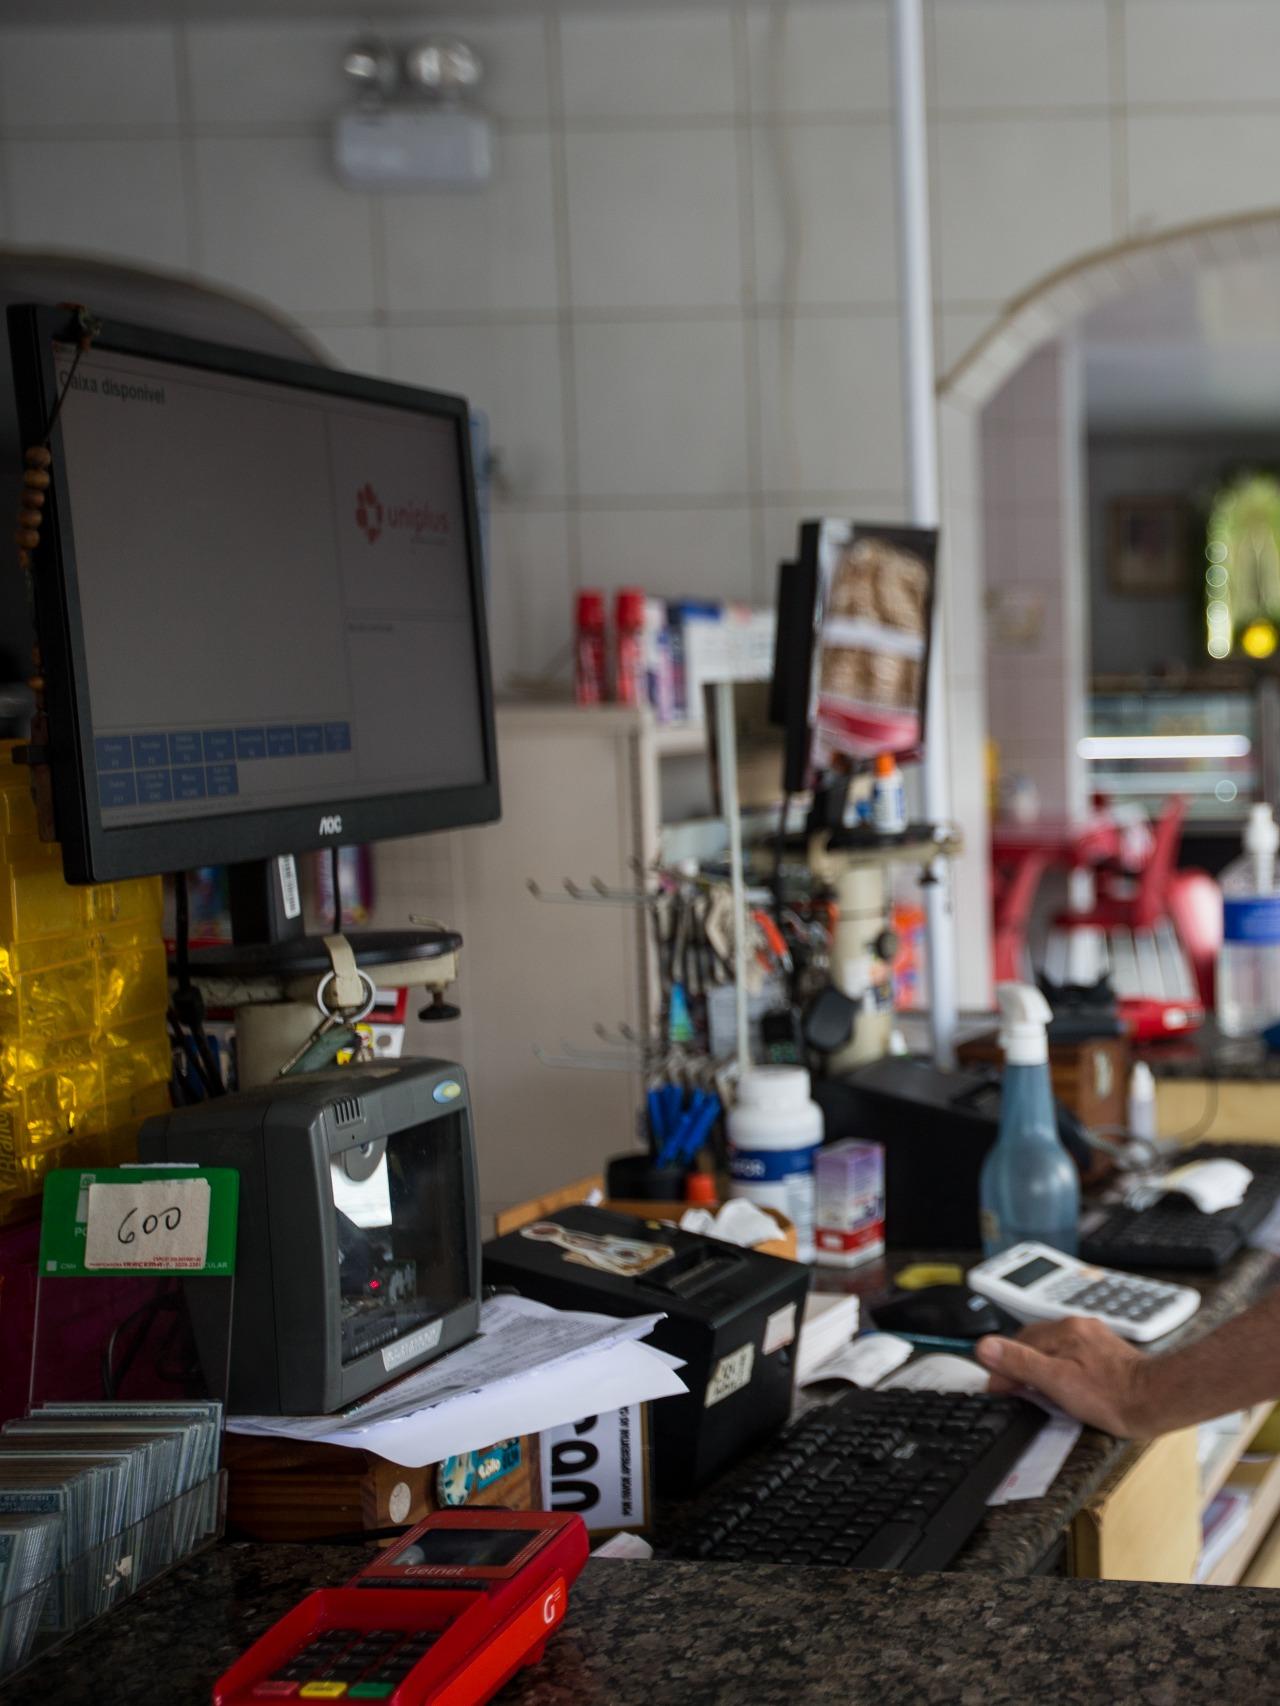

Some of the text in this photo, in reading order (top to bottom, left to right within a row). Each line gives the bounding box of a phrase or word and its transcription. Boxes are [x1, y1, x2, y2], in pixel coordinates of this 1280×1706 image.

[319, 815, 343, 836] AOC
[117, 1206, 182, 1245] 600
[404, 1566, 465, 1576] Getnet
